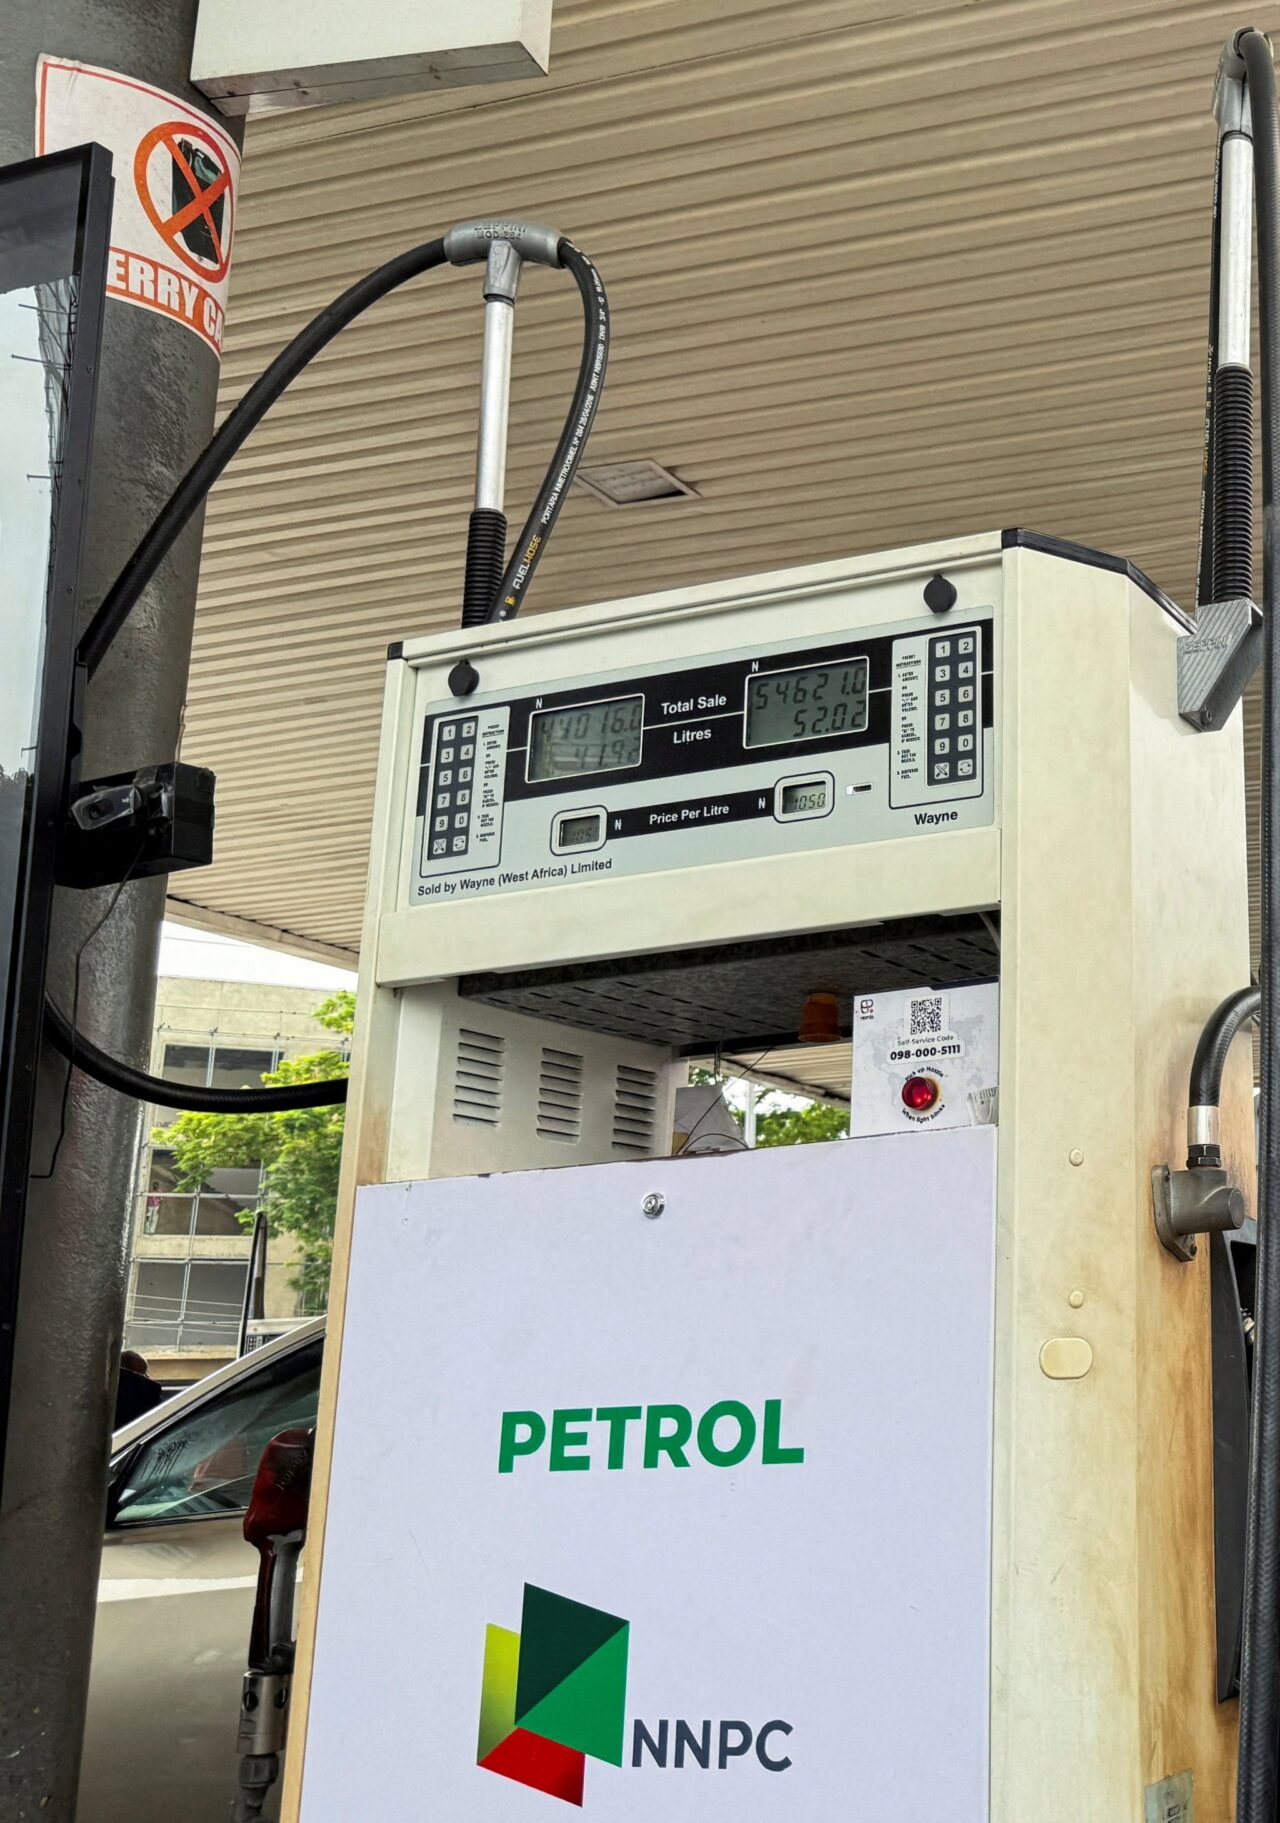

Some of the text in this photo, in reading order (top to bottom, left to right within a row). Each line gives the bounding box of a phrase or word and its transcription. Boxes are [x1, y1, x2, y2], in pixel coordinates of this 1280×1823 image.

[940, 641, 970, 654] 1 2
[752, 660, 759, 672] N
[940, 665, 969, 678] 3 4
[940, 690, 969, 702] 5 6
[536, 698, 543, 709] N
[661, 694, 727, 715] Total Sale
[793, 700, 866, 736] 52.02
[939, 714, 969, 727] 7 8
[447, 726, 473, 738] 1 2
[673, 727, 712, 744] Litres
[939, 739, 969, 751] 9 0
[444, 748, 470, 760] 3 4
[443, 770, 469, 782] 5 6
[441, 797, 447, 806] 7
[758, 798, 766, 809] N
[649, 804, 729, 825] Price Per Litre
[914, 811, 958, 826] Wayne
[439, 816, 465, 828] 9 0
[614, 819, 622, 830] N
[418, 858, 612, 896] Sold by Wayne (West Africa) Limited
[937, 1034, 954, 1042] Code
[890, 1044, 961, 1060] 098-000-5111
[498, 1398, 805, 1474] PETROL
[632, 1719, 794, 1772] NNPC
